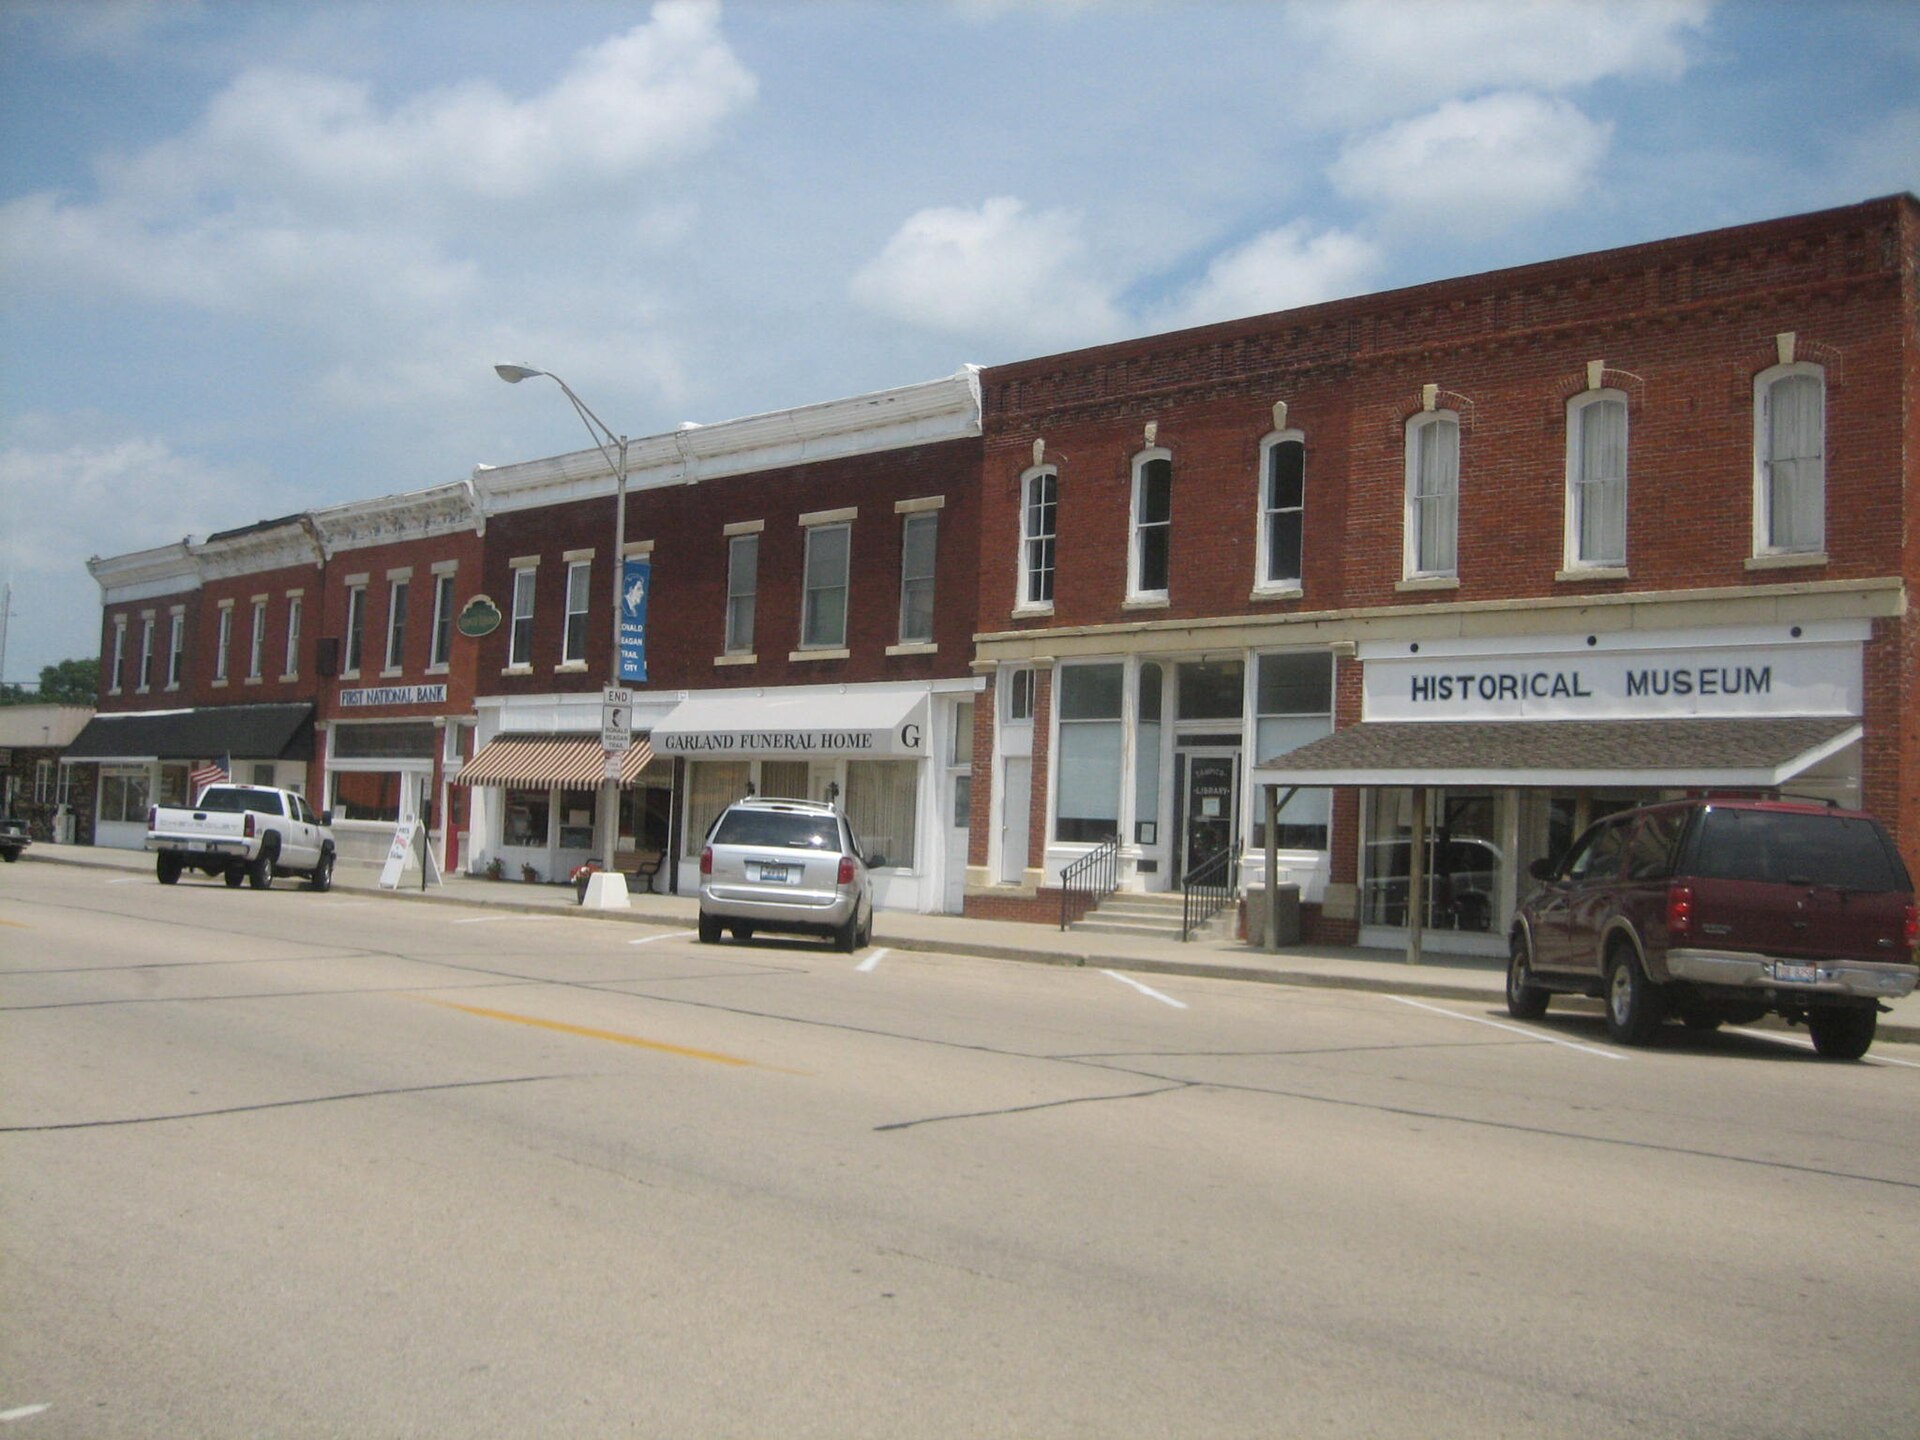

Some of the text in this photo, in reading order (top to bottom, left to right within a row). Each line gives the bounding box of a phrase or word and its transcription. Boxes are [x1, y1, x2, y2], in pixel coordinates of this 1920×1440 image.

[621, 623, 643, 632] ONALD
[621, 636, 643, 645] EAGAN
[624, 663, 638, 671] CITY
[1411, 666, 1772, 701] HISTORICAL MUSEUM
[342, 685, 444, 706] FIRST NATIONAL BANK
[608, 690, 628, 702] END
[665, 733, 872, 750] GARLAND FUNERAL HOME
[901, 724, 921, 748] G
